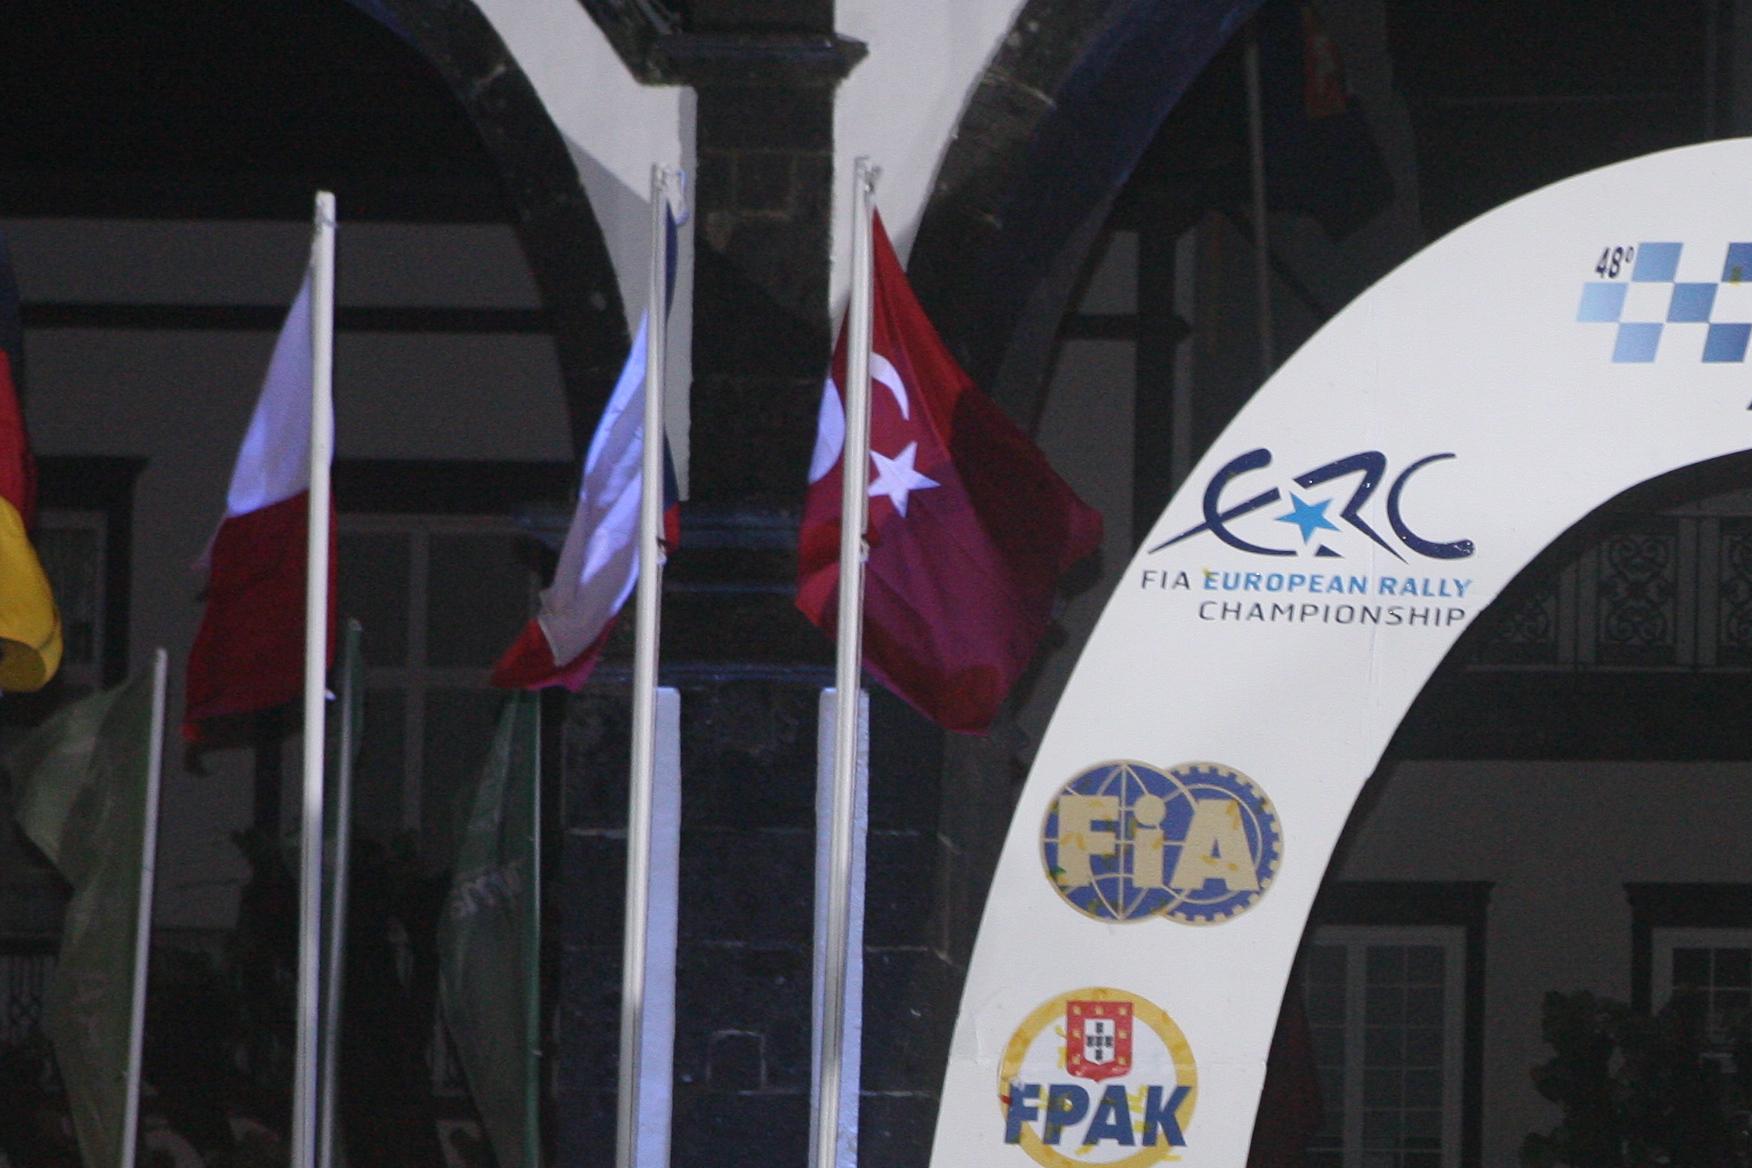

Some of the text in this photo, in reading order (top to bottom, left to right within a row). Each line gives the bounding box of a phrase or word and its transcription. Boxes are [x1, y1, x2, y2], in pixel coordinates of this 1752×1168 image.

[1141, 569, 1472, 598] FIA EUROPEAN RALLY
[1199, 600, 1466, 627] CHAMPIONSHIP
[1004, 1083, 1191, 1147] FPAK
